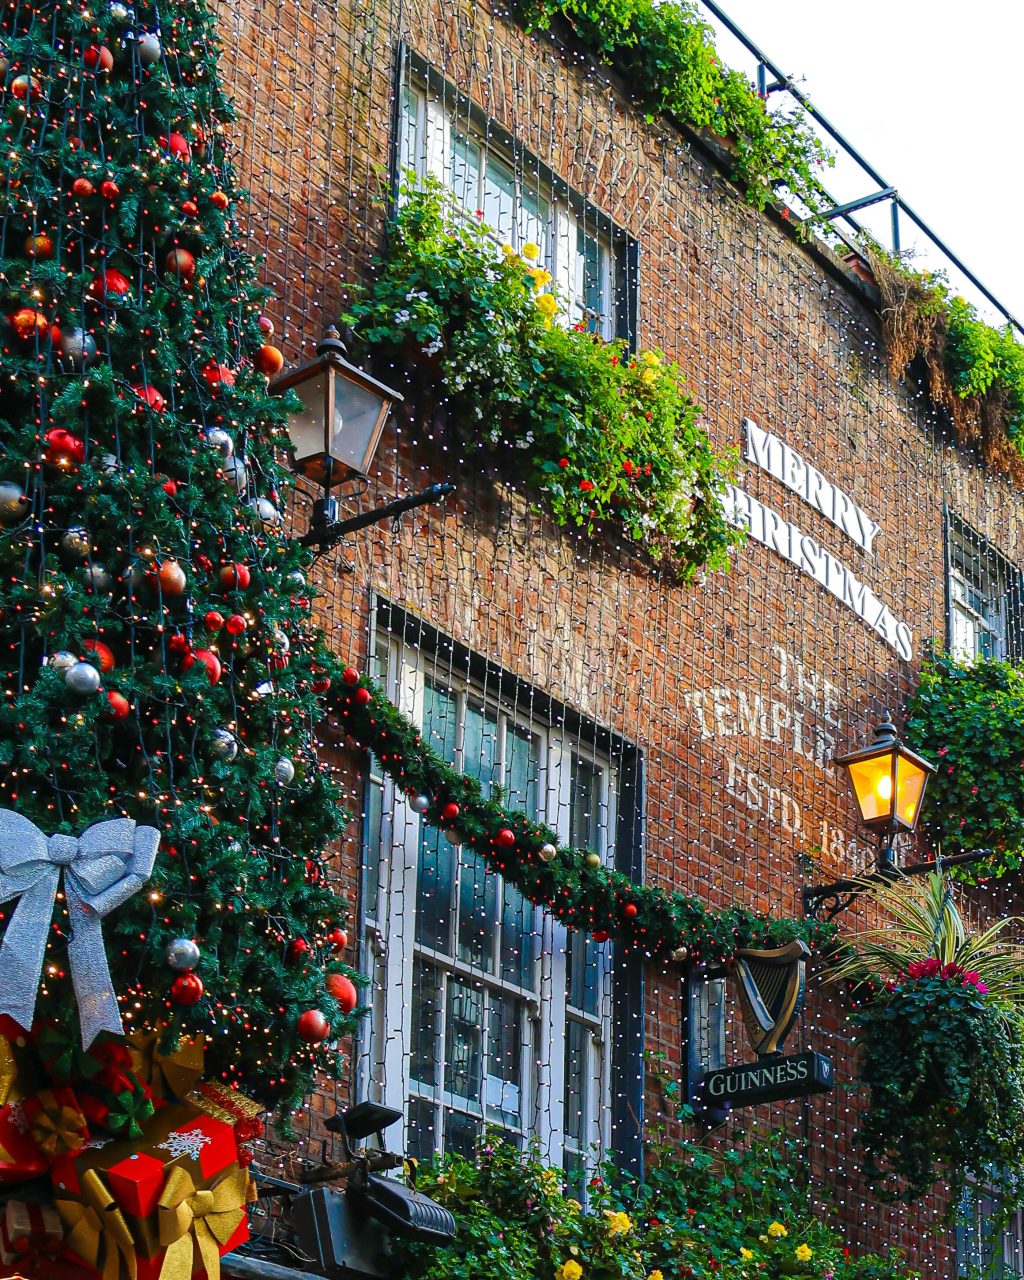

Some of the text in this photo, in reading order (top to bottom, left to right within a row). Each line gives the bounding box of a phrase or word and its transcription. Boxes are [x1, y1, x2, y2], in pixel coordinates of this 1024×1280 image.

[743, 416, 881, 558] MERRY
[775, 645, 842, 729] THE
[708, 1060, 808, 1096] GUINNESS
